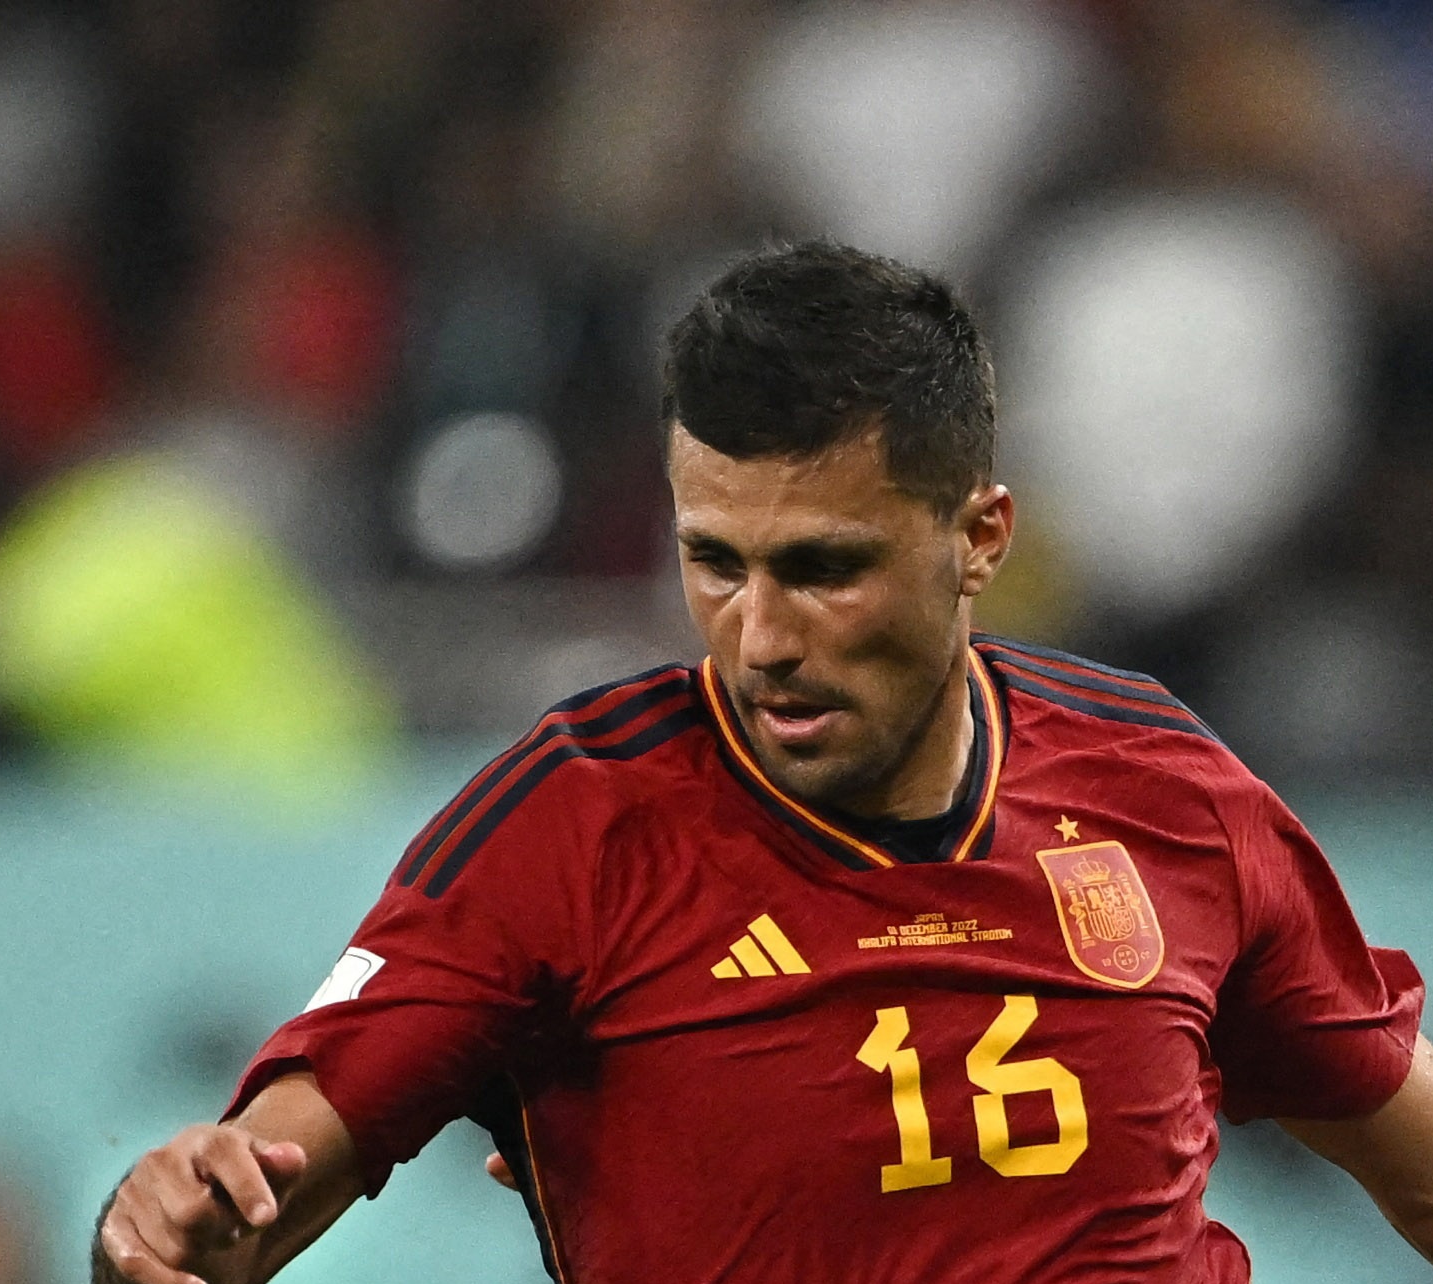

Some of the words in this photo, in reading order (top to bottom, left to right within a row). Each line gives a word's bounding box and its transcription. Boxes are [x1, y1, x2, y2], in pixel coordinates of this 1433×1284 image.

[899, 922, 948, 936] DECEMBER
[952, 919, 978, 932] 2022
[914, 912, 945, 924] JAPAN
[857, 937, 897, 949] KHALIFA
[898, 932, 969, 947] INTERNATIONAL
[971, 928, 1013, 942] STADIUM
[856, 995, 1088, 1193] 16
